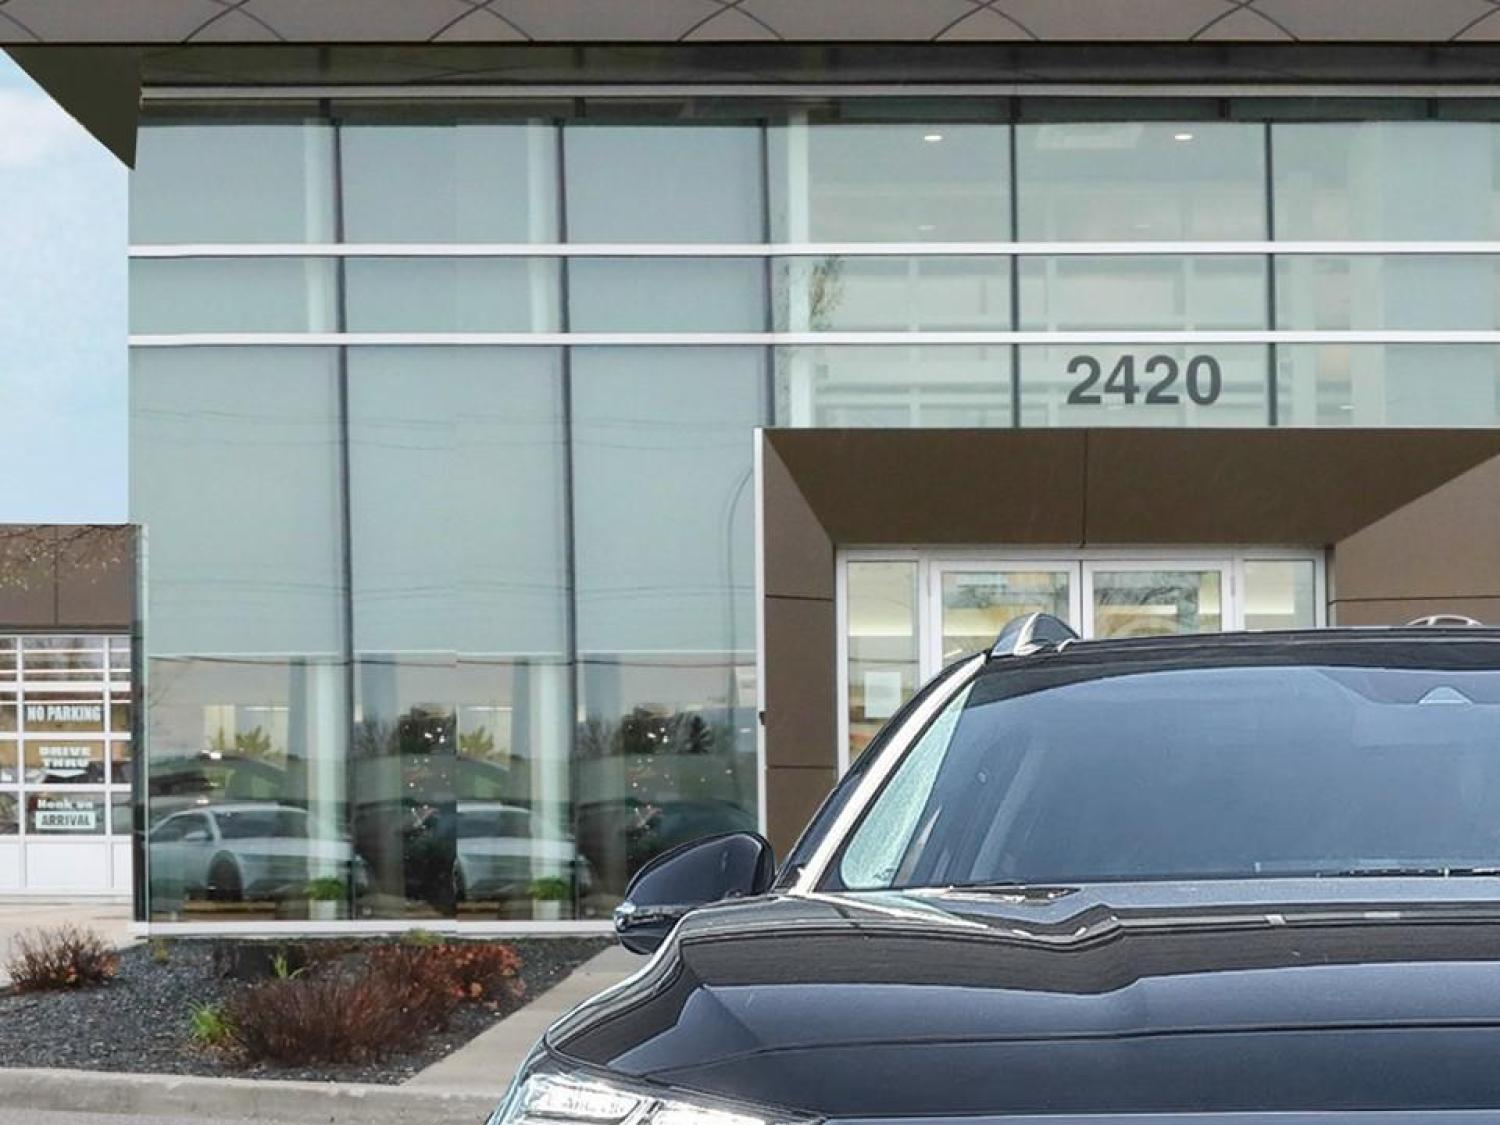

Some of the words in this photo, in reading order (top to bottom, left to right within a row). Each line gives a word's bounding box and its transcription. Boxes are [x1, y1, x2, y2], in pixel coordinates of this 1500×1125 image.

[1066, 354, 1222, 406] 2420
[27, 705, 46, 721] NO
[47, 705, 101, 721] PARKING
[41, 813, 91, 826] ARRIVAL
